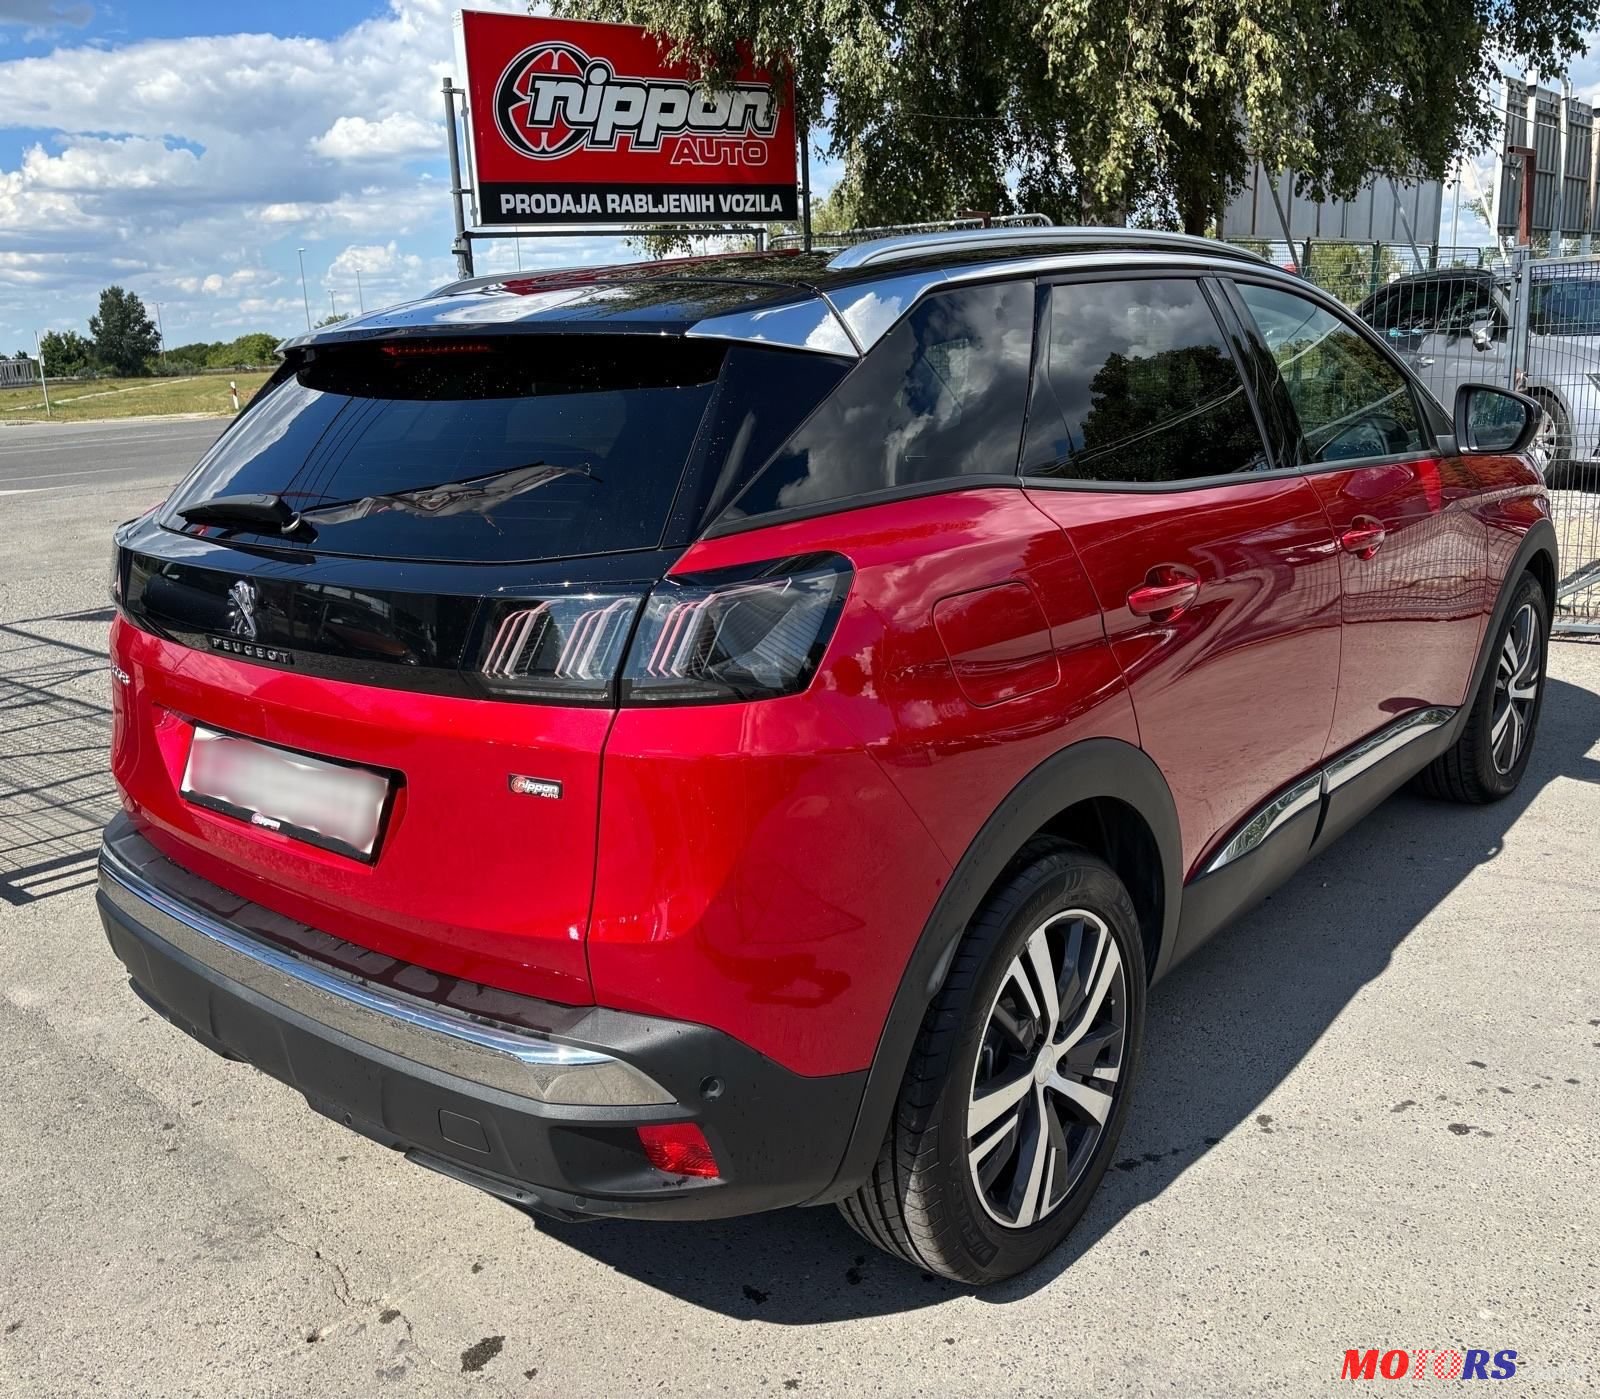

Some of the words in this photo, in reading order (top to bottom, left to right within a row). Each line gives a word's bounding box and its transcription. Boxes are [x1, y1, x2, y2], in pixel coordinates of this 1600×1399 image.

[532, 64, 775, 146] nippon
[670, 138, 769, 166] AUTO
[500, 193, 602, 214] PRODAJA
[607, 193, 715, 214] RABLJENIH
[719, 193, 783, 213] VOZILA
[211, 637, 291, 663] PEUGEOT
[517, 779, 559, 795] nippon
